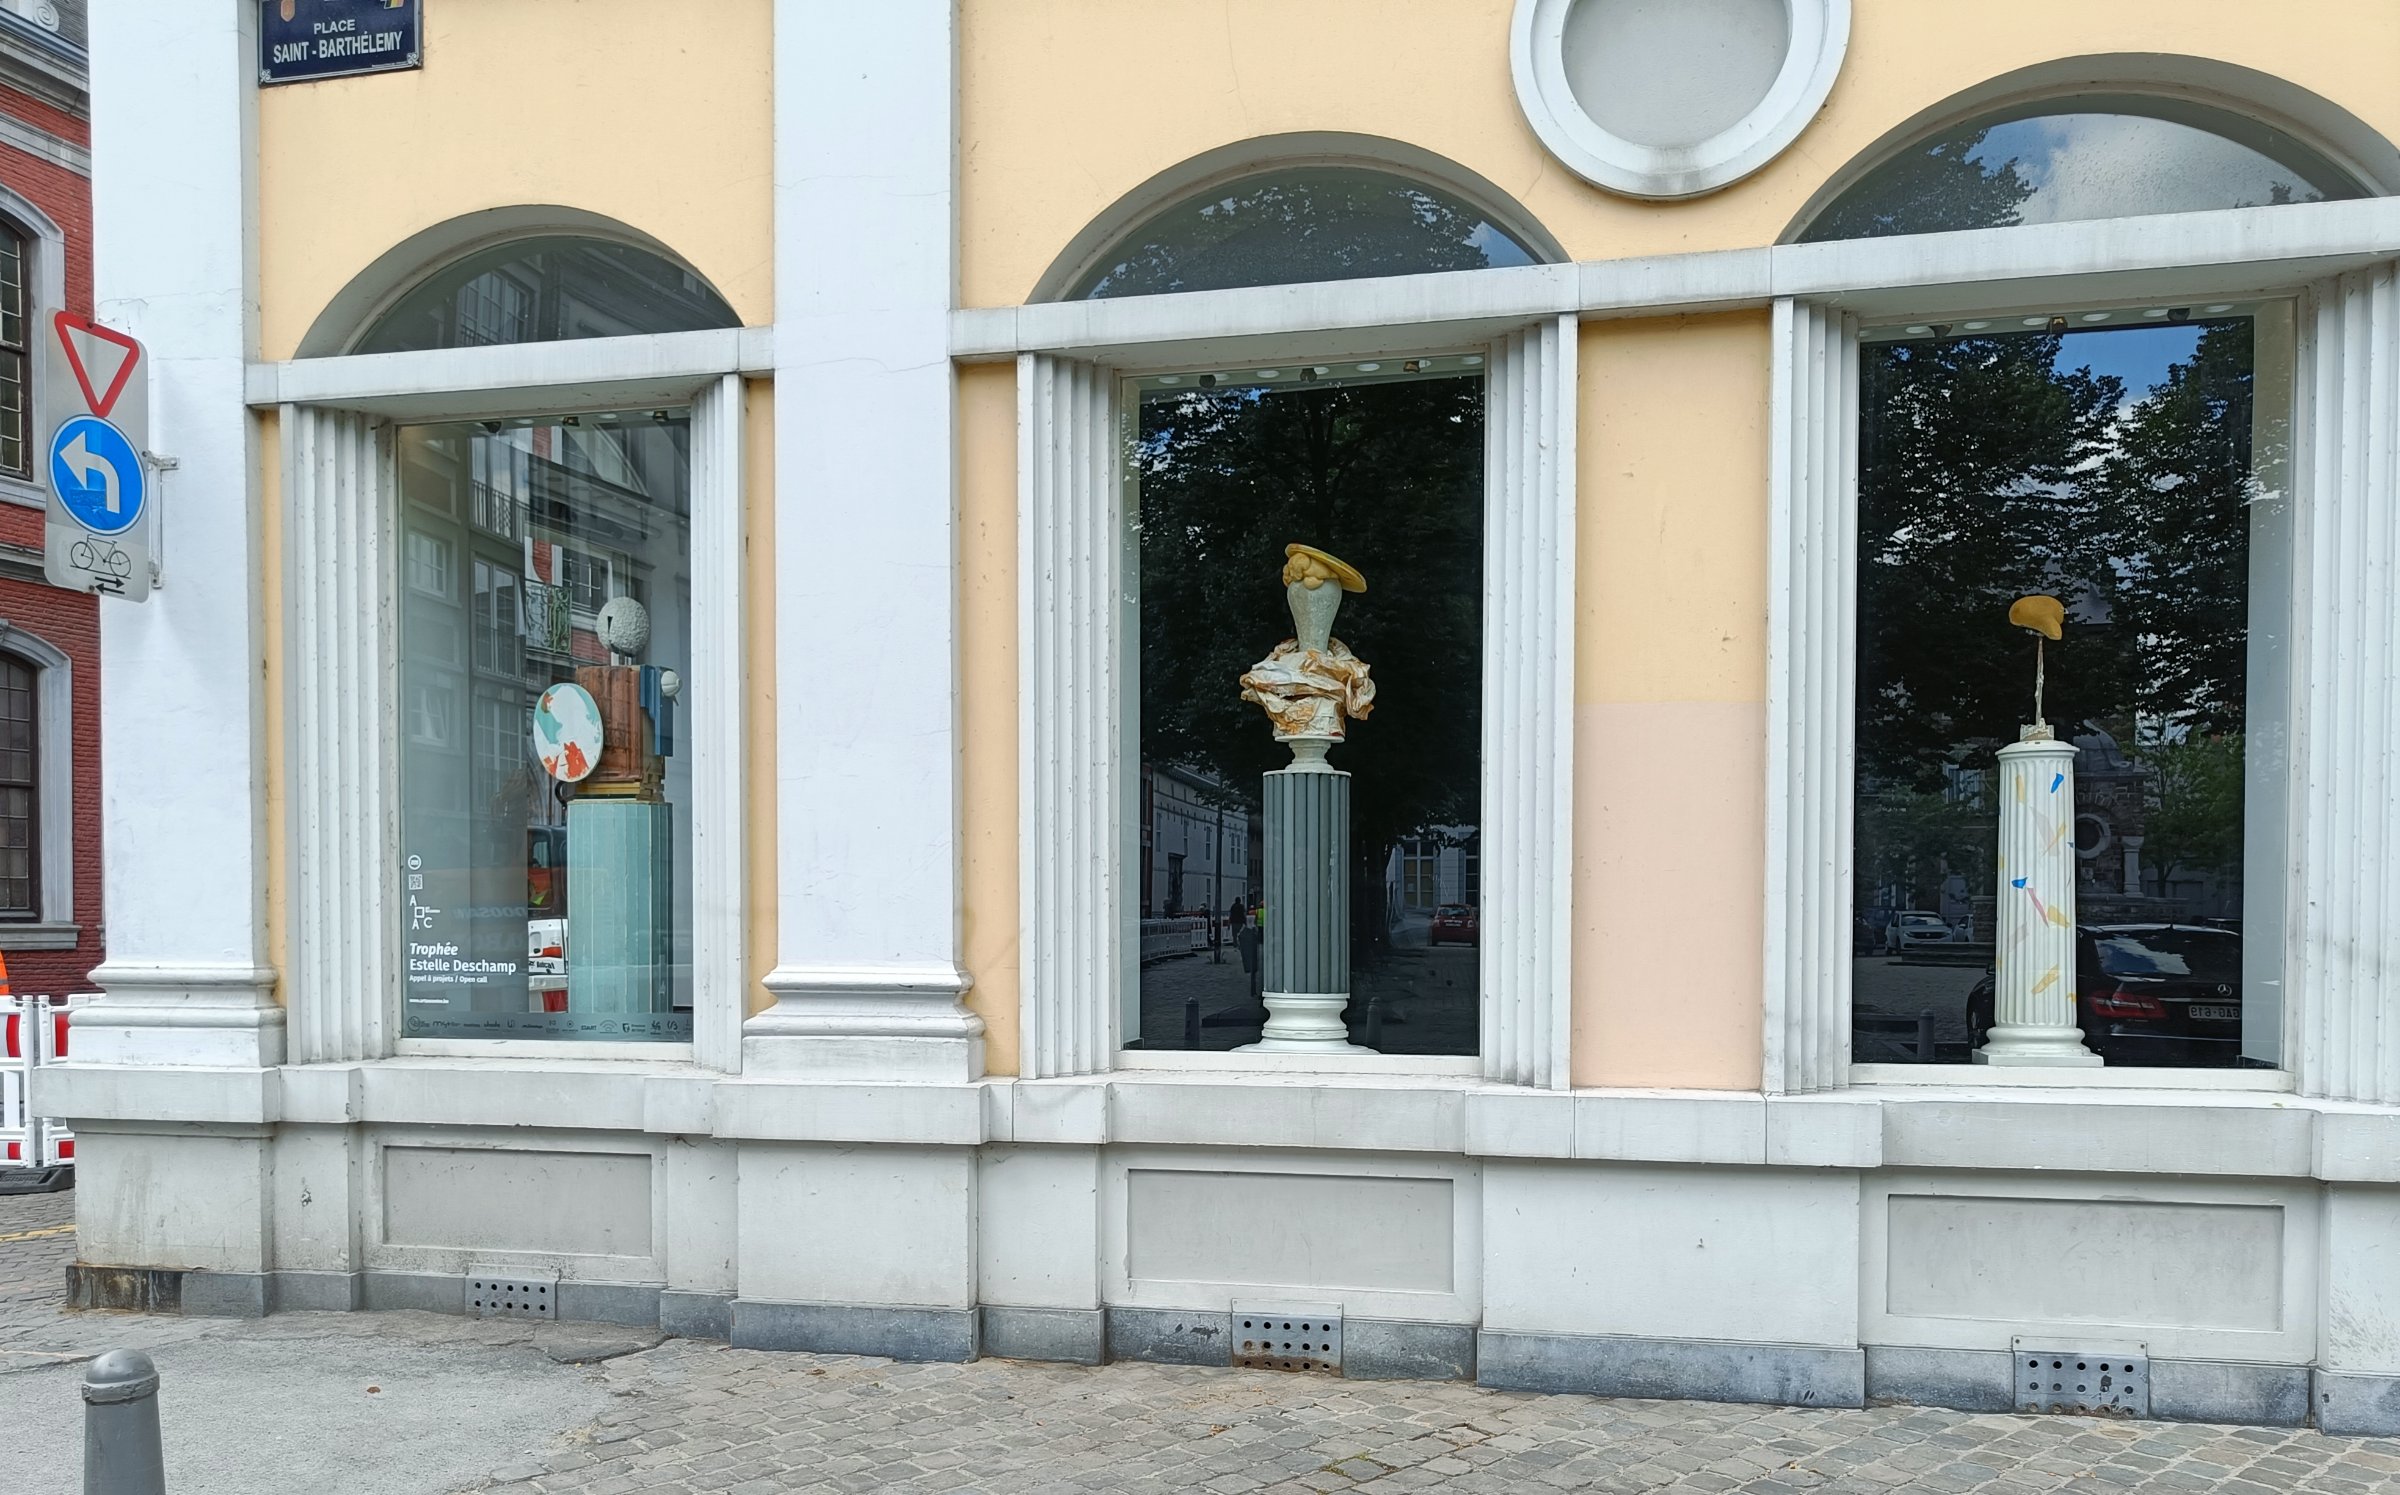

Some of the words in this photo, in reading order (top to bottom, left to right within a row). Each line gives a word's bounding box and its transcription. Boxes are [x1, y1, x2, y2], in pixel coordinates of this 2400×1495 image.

[313, 19, 356, 35] PLACE
[410, 942, 459, 958] Trophée
[410, 959, 450, 971] Estelle
[453, 959, 517, 975] Deschamp
[433, 975, 454, 983] projets
[459, 976, 476, 984] Open
